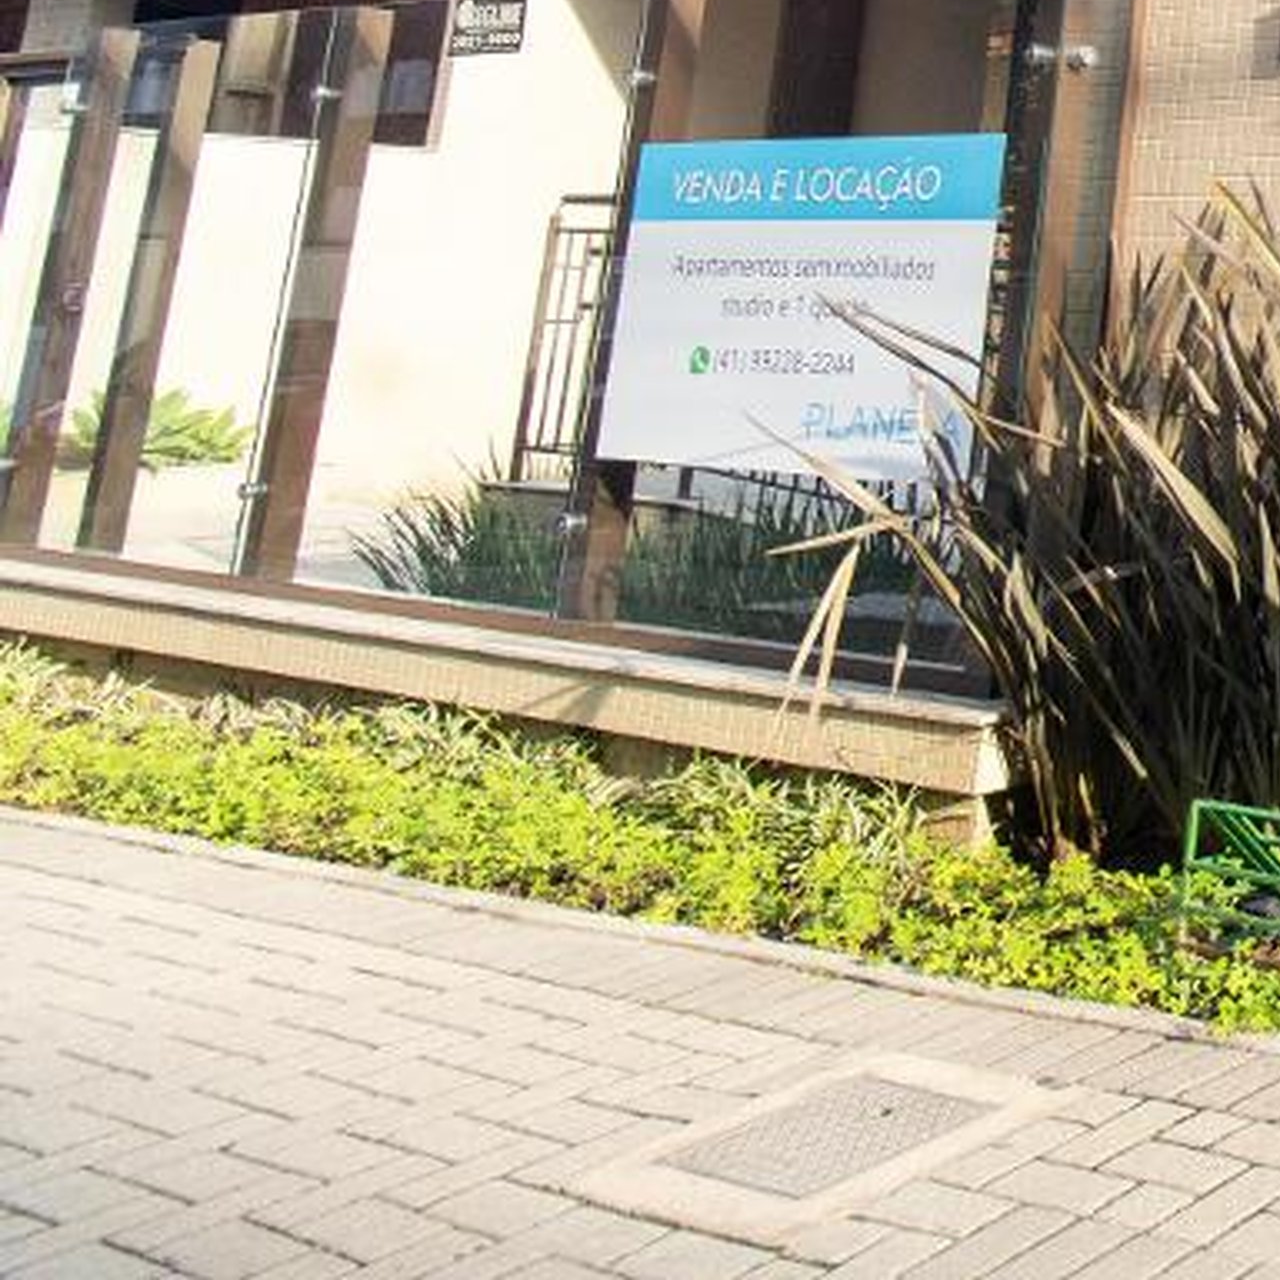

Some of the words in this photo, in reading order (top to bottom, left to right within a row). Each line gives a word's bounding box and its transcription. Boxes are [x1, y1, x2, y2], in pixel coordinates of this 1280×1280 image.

[674, 169, 762, 203] VENDA
[770, 169, 790, 202] E
[795, 157, 942, 210] LOCAÇÃO
[672, 255, 788, 281] Apartamentos
[778, 299, 792, 317] e
[713, 347, 747, 375] (41)
[801, 401, 962, 448] PLANEA
